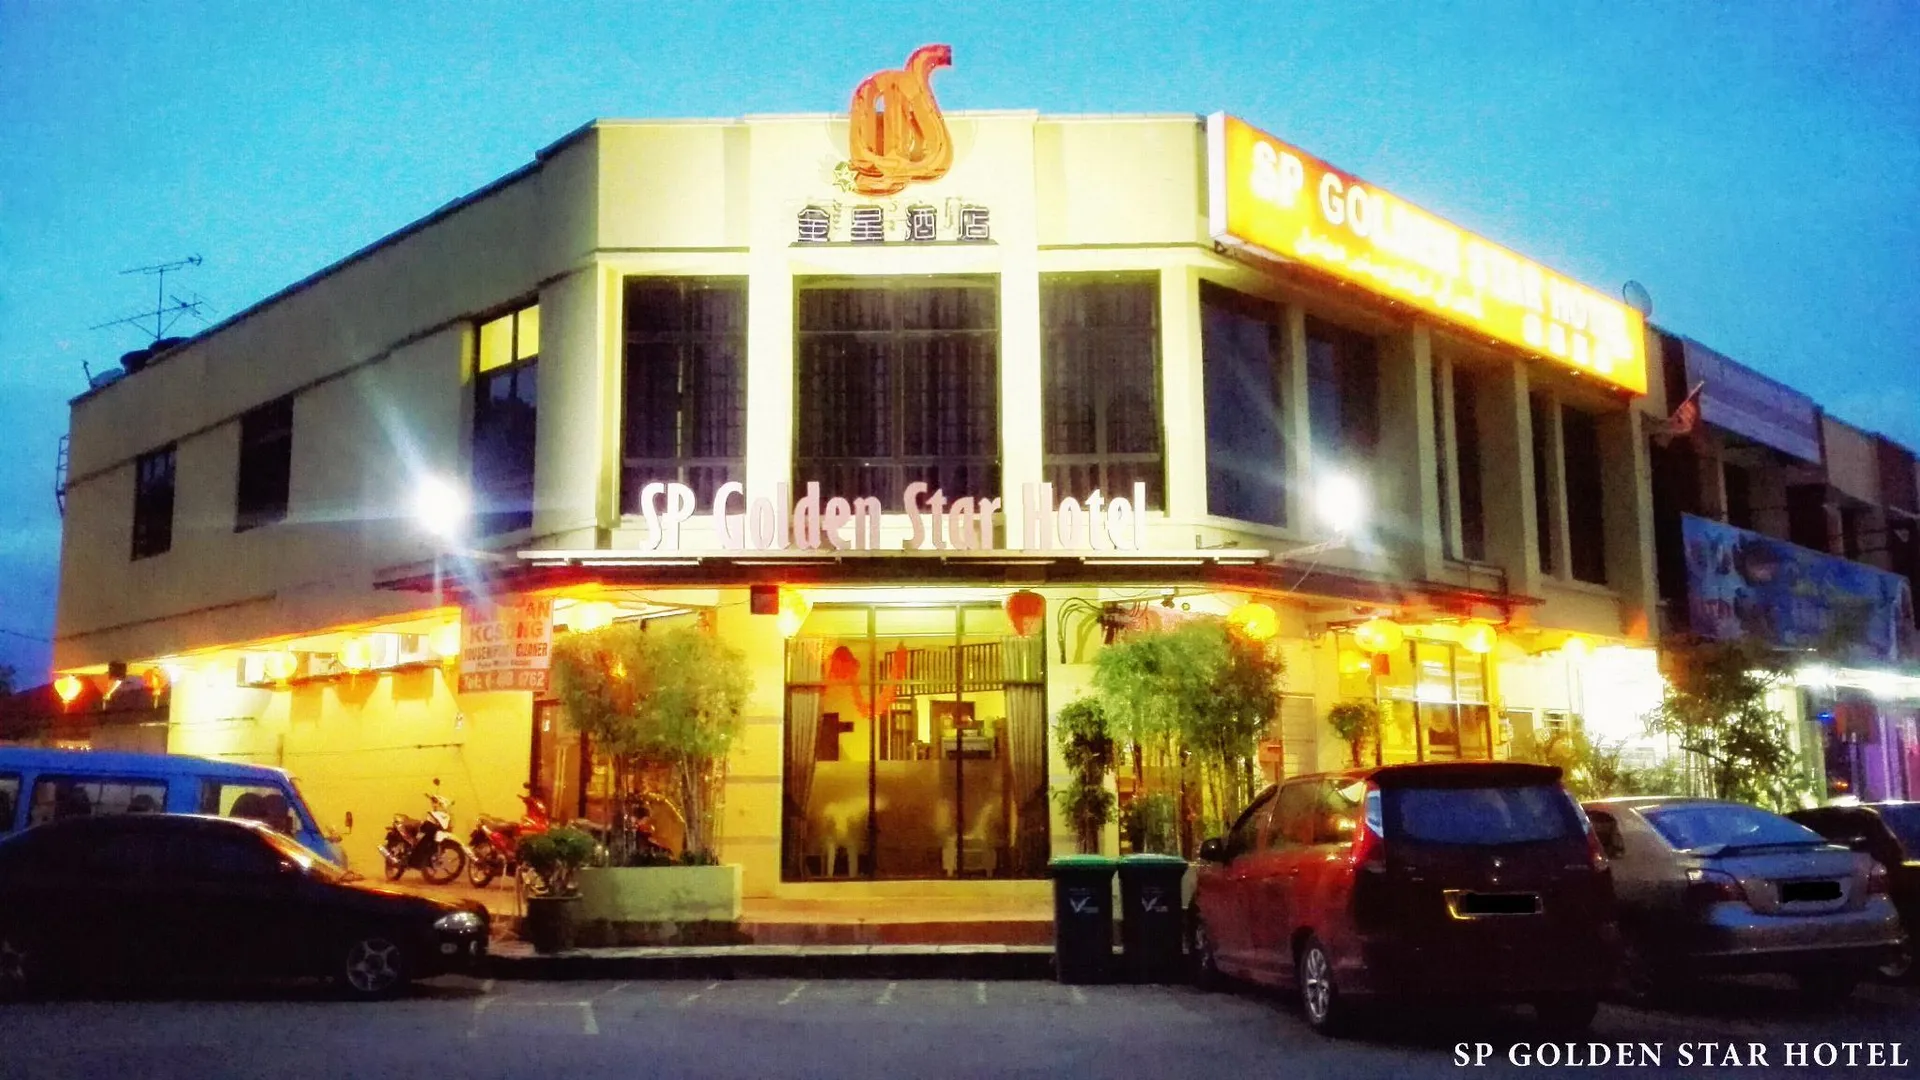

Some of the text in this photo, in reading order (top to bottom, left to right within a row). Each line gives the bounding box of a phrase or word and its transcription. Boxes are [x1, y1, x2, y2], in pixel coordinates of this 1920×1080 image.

[1251, 140, 1304, 210] SP
[797, 203, 990, 241] 金星酒店
[640, 481, 1146, 551] SP Golden Star Hotel
